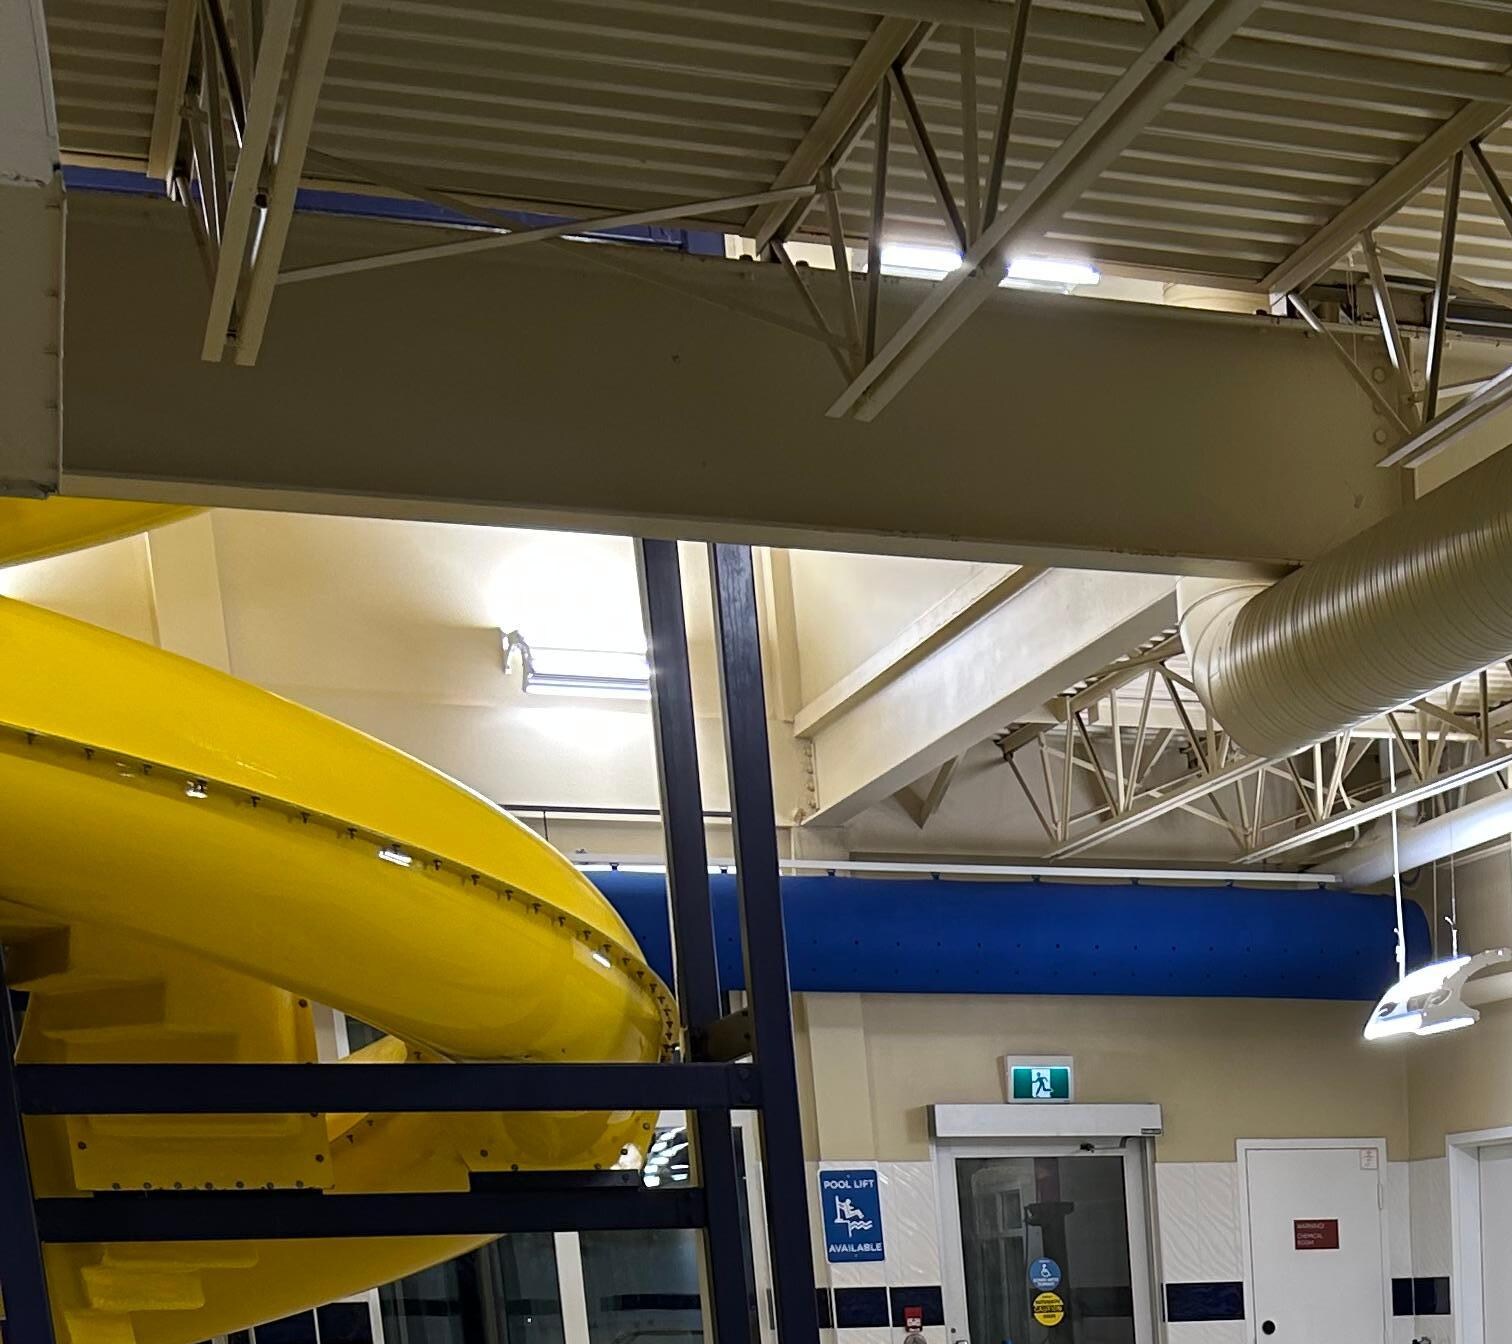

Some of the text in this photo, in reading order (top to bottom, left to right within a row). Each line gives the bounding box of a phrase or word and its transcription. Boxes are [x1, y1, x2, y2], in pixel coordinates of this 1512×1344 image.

[824, 1179, 875, 1189] POOL LIFT
[829, 1242, 883, 1253] AVAILABLE
